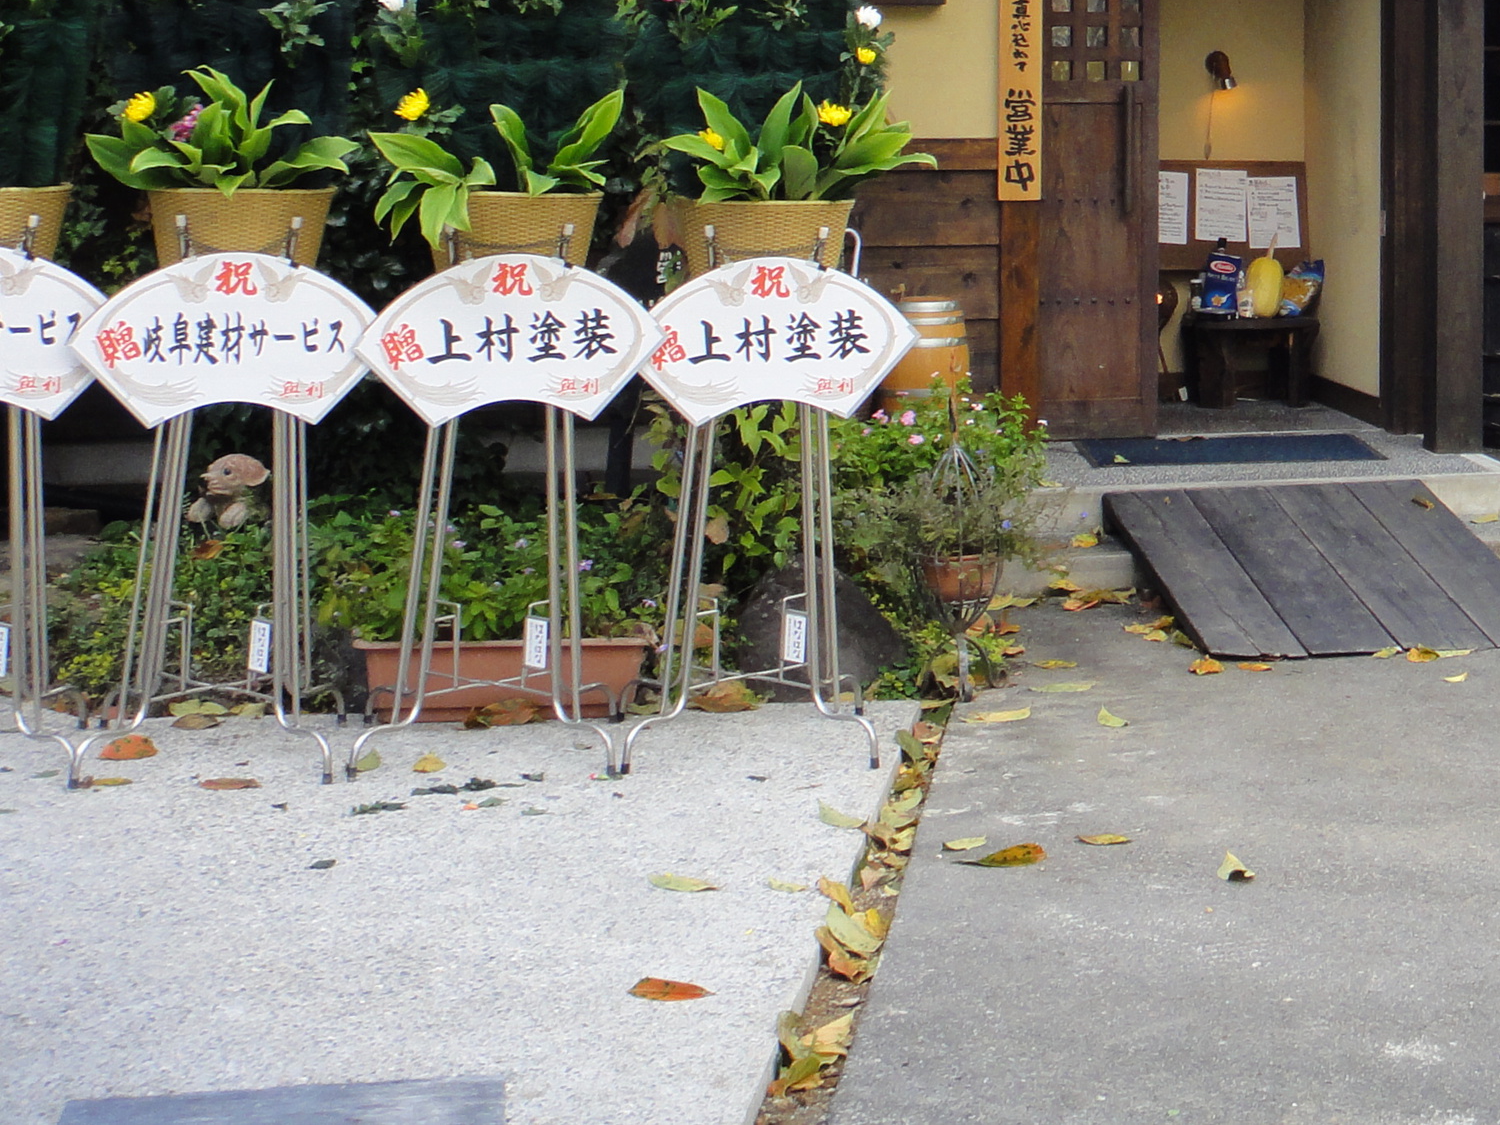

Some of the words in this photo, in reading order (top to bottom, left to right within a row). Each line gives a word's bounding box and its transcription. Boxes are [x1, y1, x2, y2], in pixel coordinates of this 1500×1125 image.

[1004, 87, 1037, 192] 営業中
[215, 261, 258, 296] 祝
[491, 263, 534, 296] 祝
[750, 265, 791, 299] 祝
[0, 310, 82, 346] ービス
[143, 311, 347, 366] 岐阜建材サービス
[380, 323, 425, 371] 贈
[427, 308, 616, 365] 上村塗装
[688, 309, 870, 365] 上村塗装
